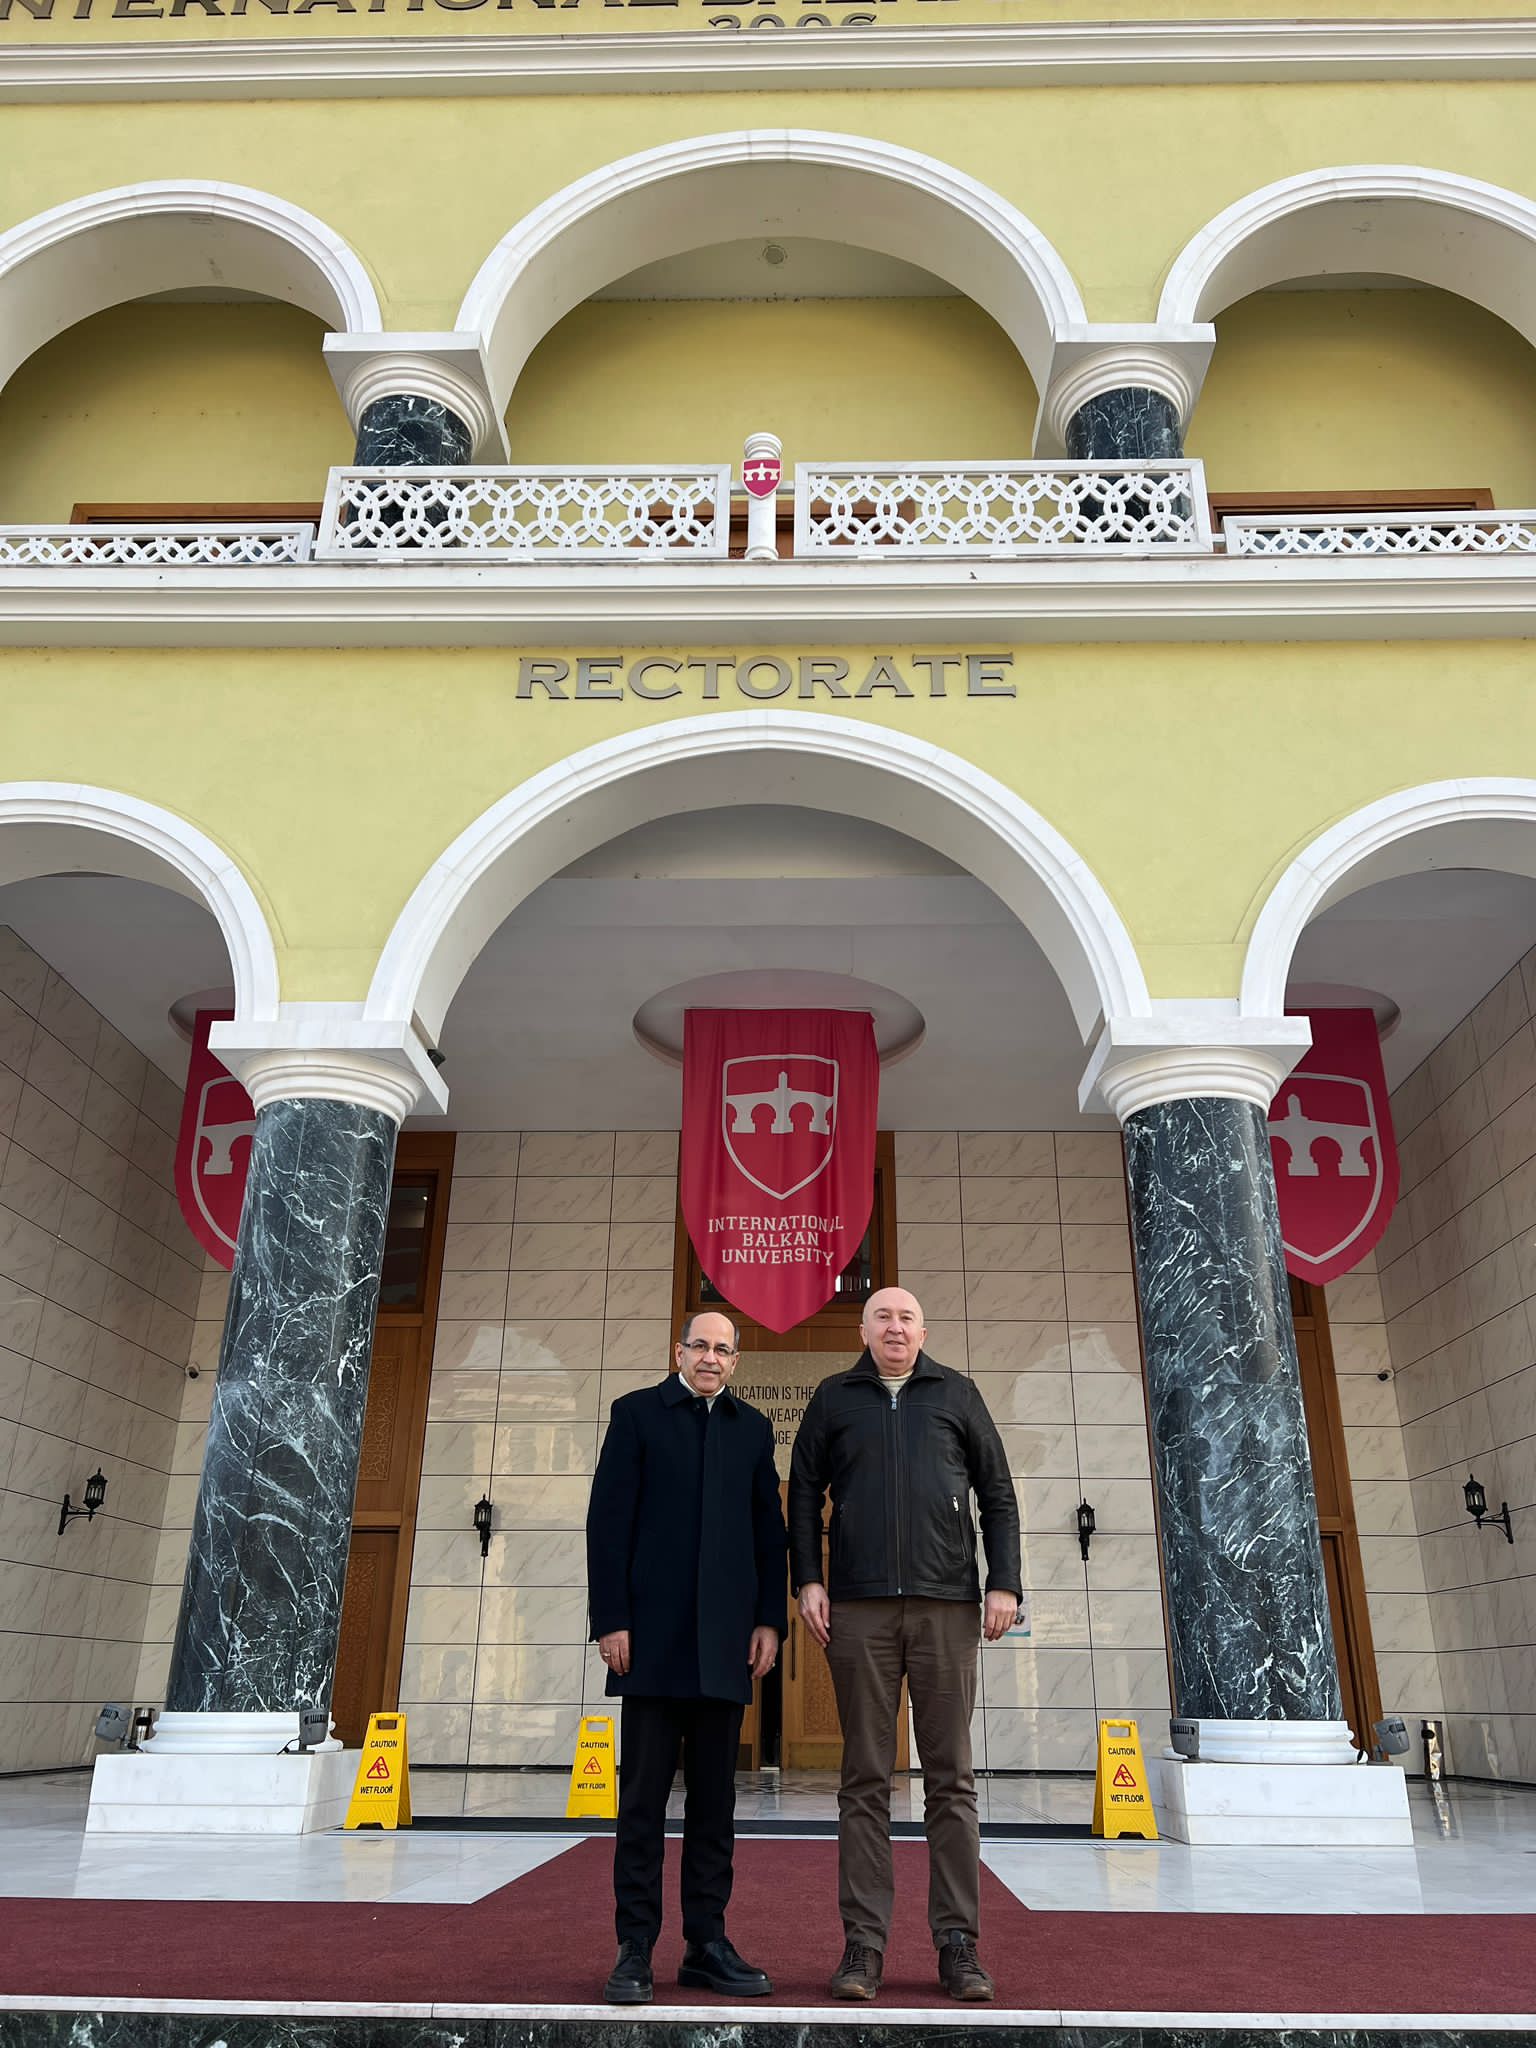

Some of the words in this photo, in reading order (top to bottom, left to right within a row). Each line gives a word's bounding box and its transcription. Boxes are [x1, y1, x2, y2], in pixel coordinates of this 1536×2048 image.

[515, 653, 1017, 700] RECTORATE
[742, 1231, 819, 1247] BALKAN
[722, 1248, 834, 1266] UNIVERSITY
[728, 1385, 779, 1400] DUCATION
[782, 1386, 791, 1400] IS
[793, 1386, 815, 1400] THE
[766, 1408, 805, 1422] WEAPO
[370, 1740, 398, 1748] CAUTION
[580, 1741, 609, 1749] CAUTION
[1107, 1747, 1136, 1755] CAUTION
[360, 1786, 373, 1794] WET
[374, 1784, 393, 1794] FLOOR
[589, 1782, 606, 1790] FLOOR
[1110, 1794, 1123, 1802] WET
[1124, 1794, 1144, 1802] FLOOR
